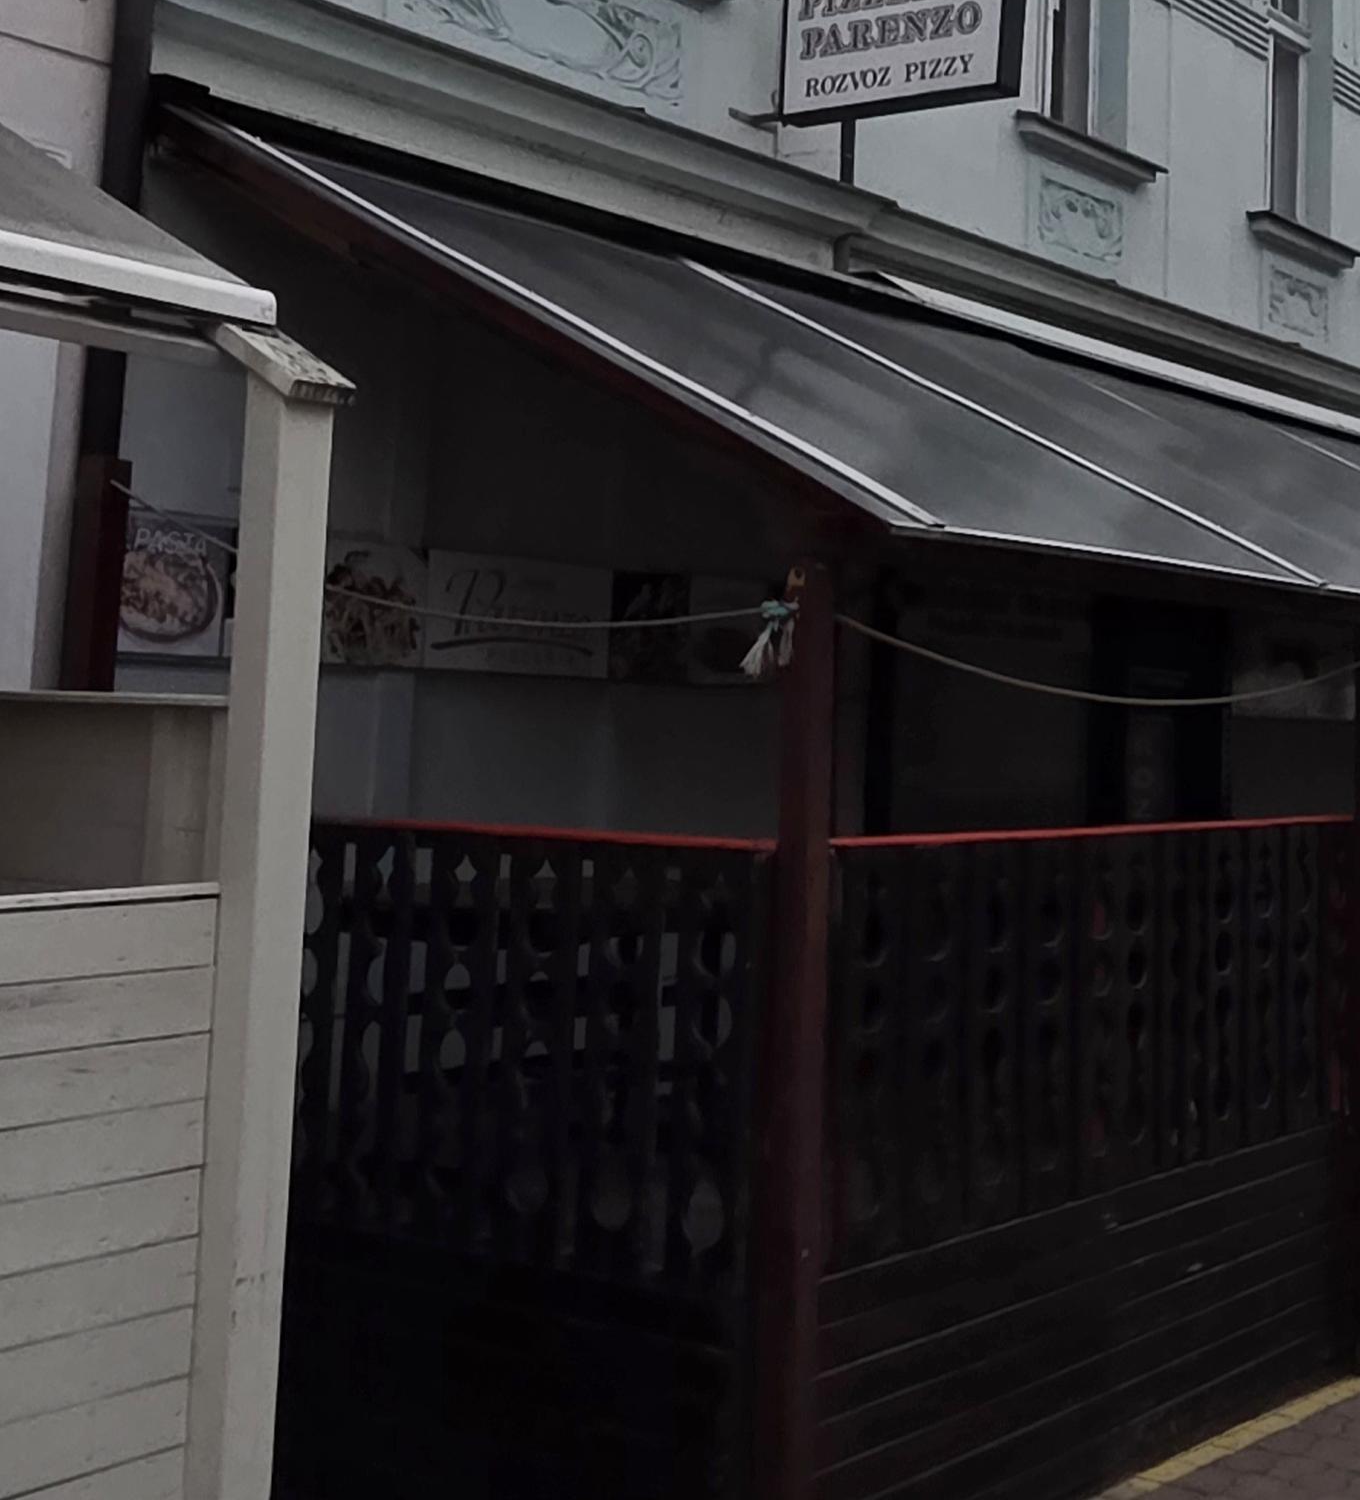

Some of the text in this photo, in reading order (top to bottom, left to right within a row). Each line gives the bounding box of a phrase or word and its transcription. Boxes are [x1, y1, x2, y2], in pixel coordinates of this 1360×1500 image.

[800, 1, 982, 60] PARENZO
[805, 53, 974, 98] ROZVOZ PIZZY
[134, 528, 208, 557] PASTA
